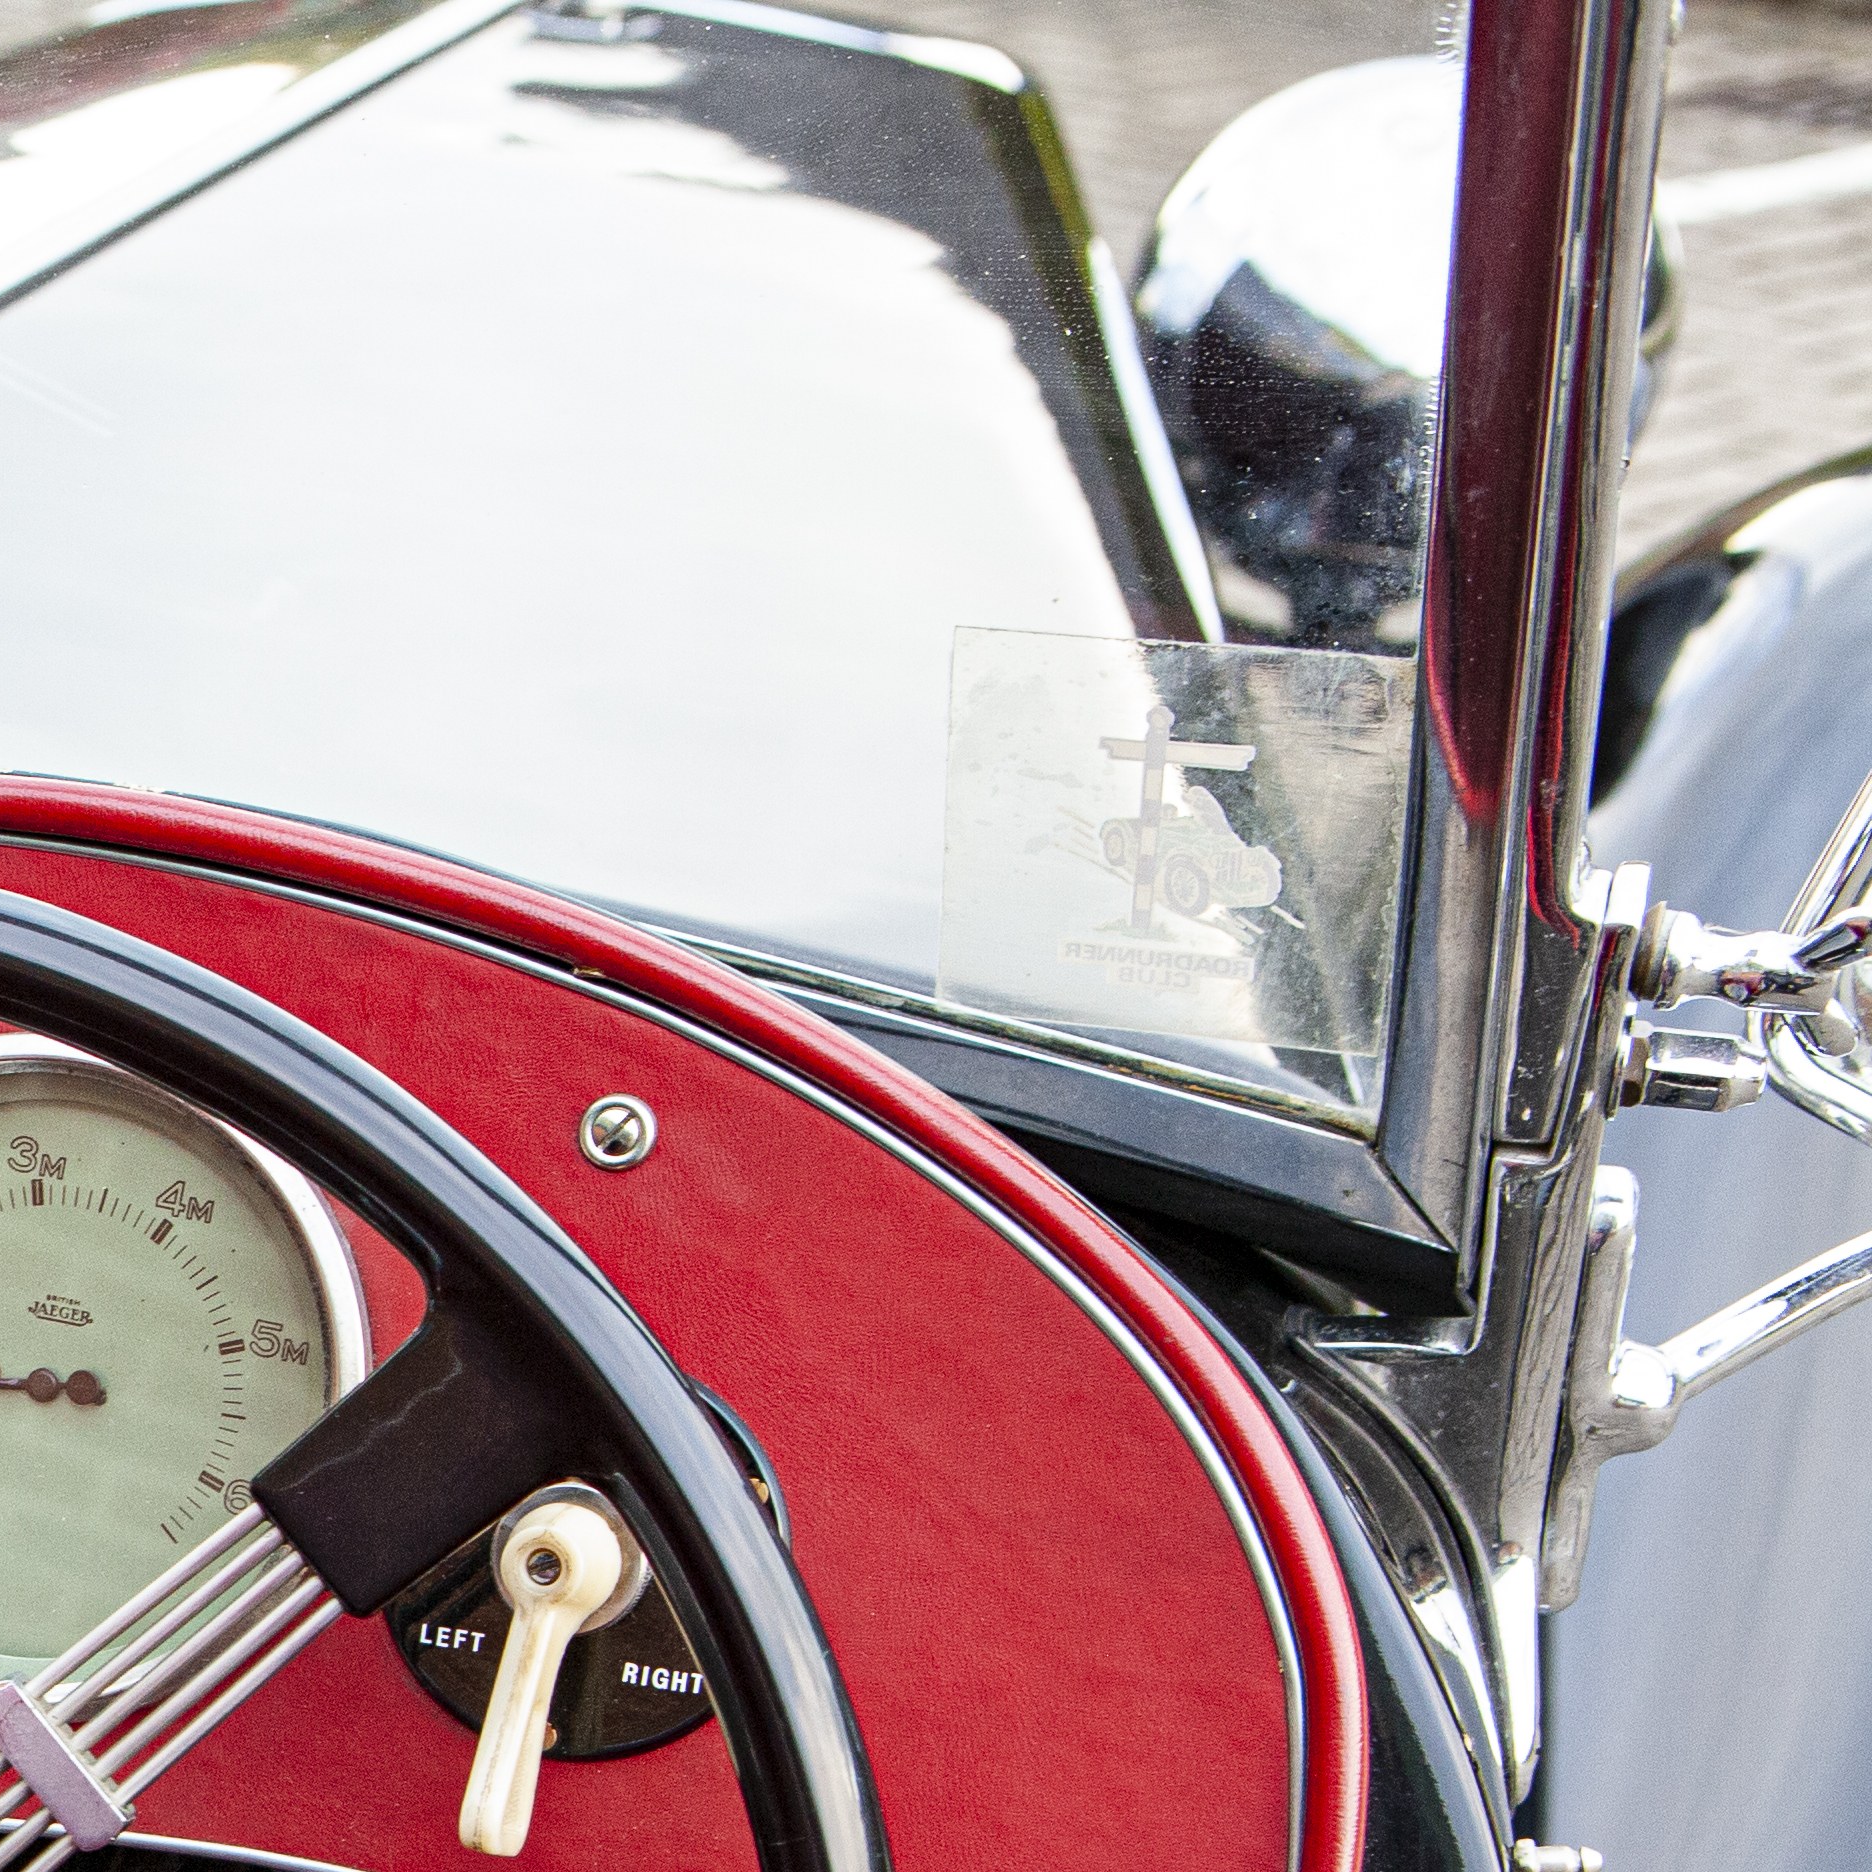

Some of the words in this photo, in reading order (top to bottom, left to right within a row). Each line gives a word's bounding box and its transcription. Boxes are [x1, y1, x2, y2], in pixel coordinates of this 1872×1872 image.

[8, 1135, 67, 1181] 3M
[155, 1180, 215, 1224] 4M
[27, 1300, 94, 1327] JAEGER
[249, 1319, 310, 1366] 5M
[419, 1622, 486, 1652] LEFT
[621, 1661, 704, 1695] RIGHT
